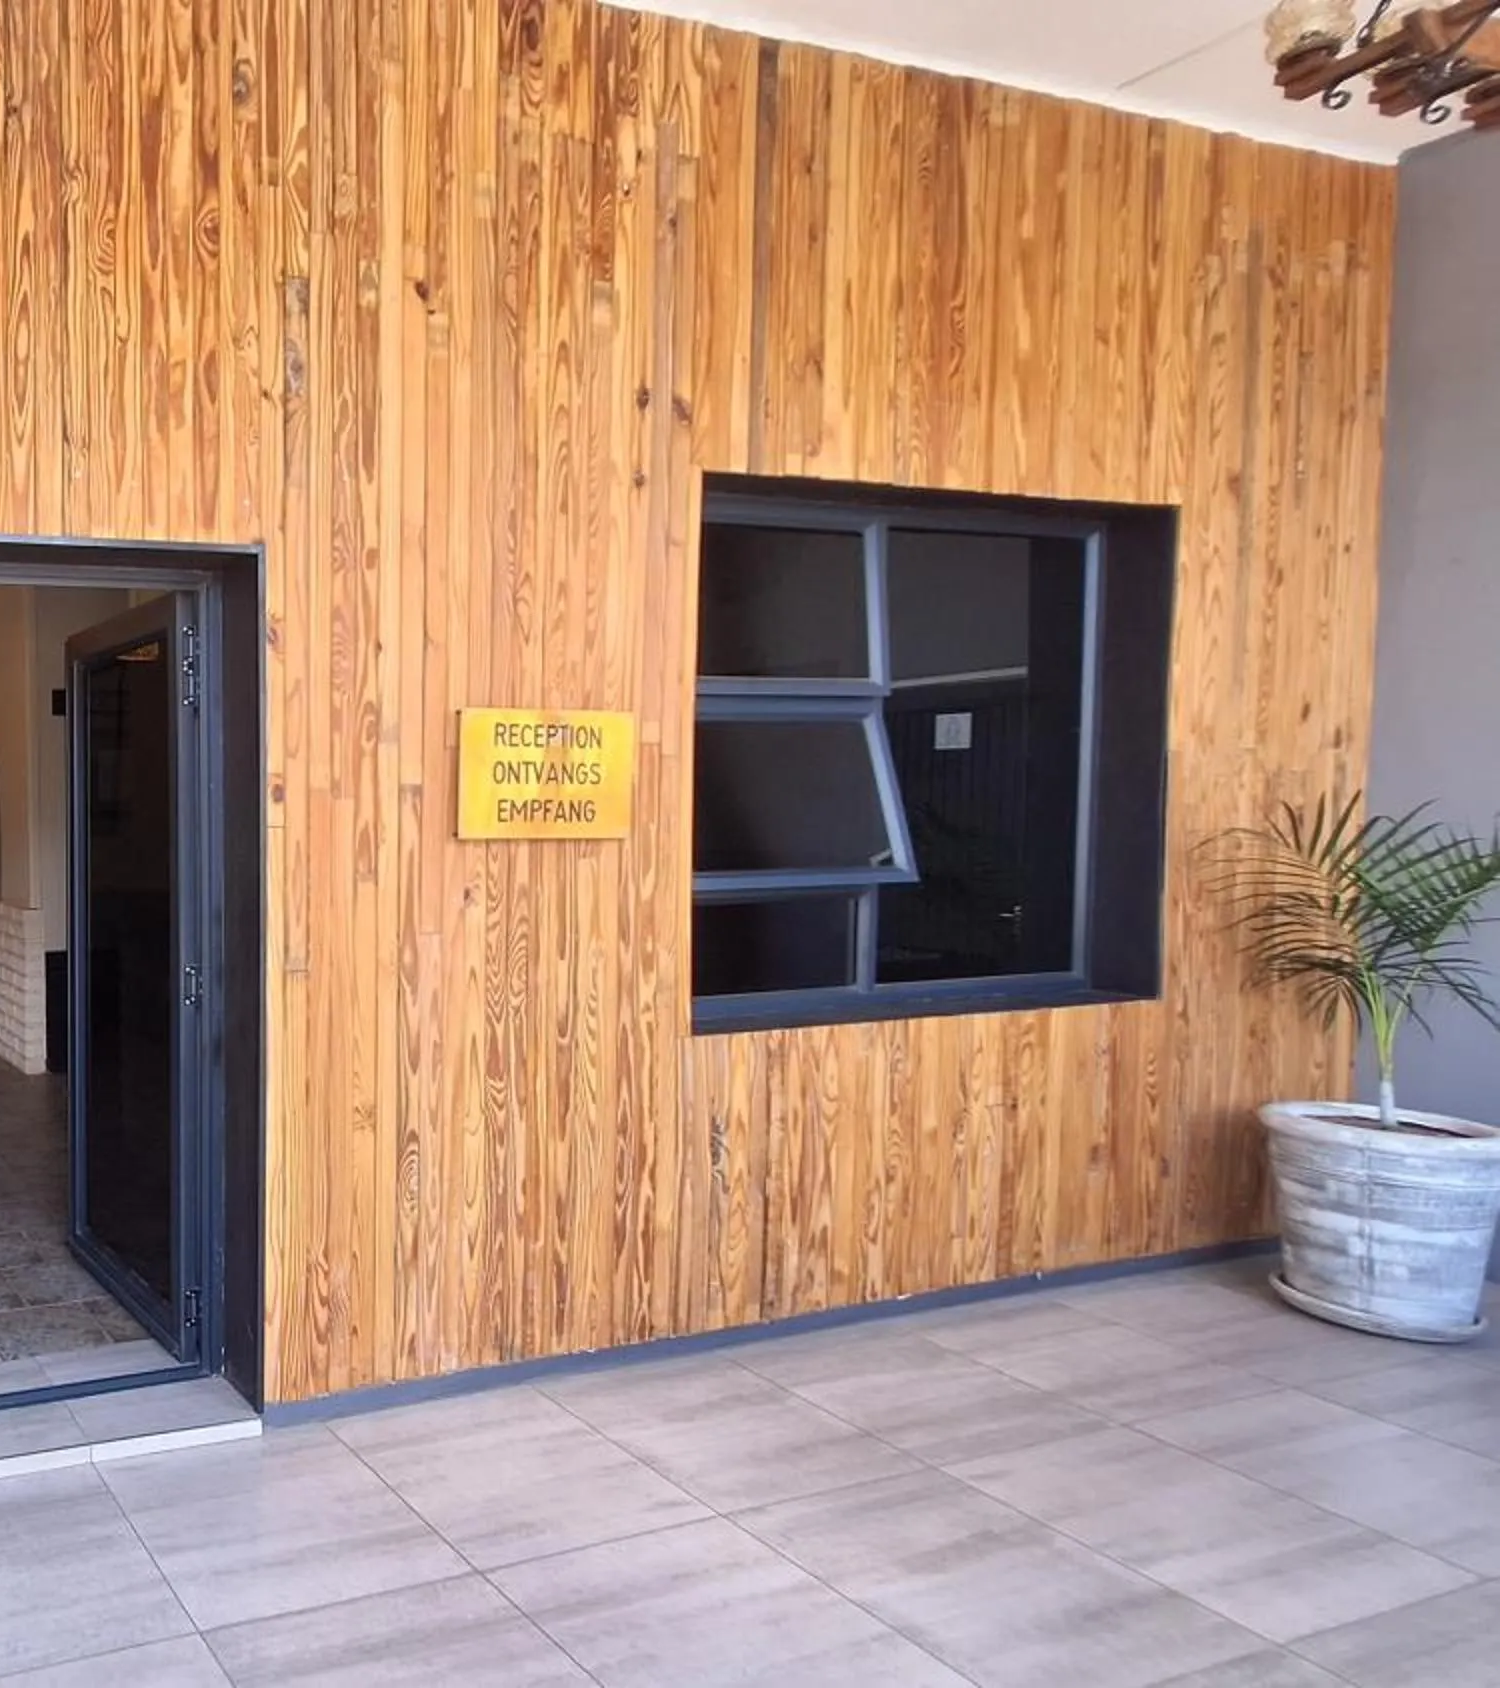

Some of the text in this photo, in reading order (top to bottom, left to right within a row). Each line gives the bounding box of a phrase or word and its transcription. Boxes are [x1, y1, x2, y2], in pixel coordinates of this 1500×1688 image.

[494, 722, 603, 749] RECEPTION
[493, 760, 601, 785] ONTVANGS
[497, 799, 597, 824] EMPFANG
